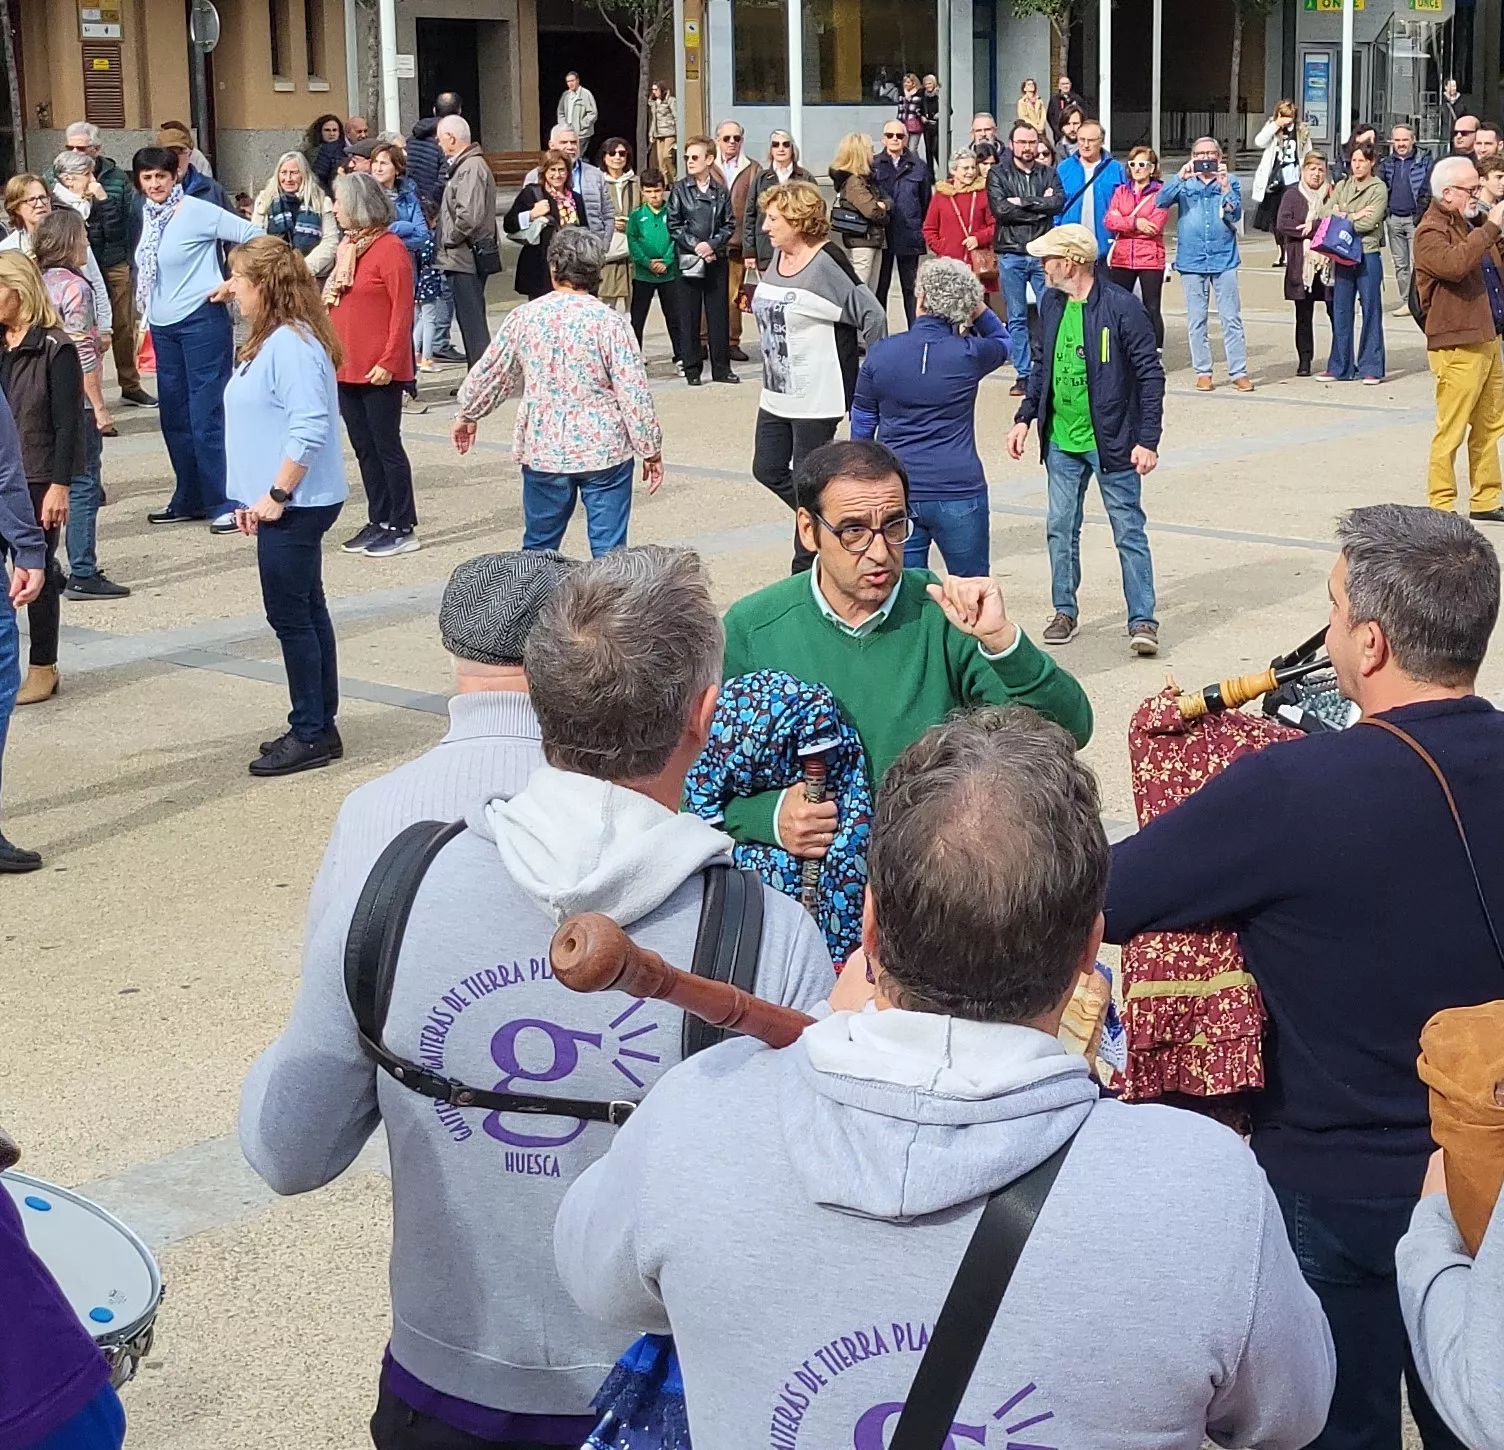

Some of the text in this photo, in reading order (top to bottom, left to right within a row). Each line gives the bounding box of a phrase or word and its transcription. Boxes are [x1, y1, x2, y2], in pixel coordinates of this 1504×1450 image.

[419, 1005, 455, 1070] GAITERAS
[441, 987, 471, 1013] DE
[460, 960, 525, 999] TIERRA
[504, 1151, 561, 1178] HUESCA
[770, 1382, 811, 1450] AITERAS
[793, 1360, 829, 1395] DE
[814, 1325, 891, 1376] TIERRA
